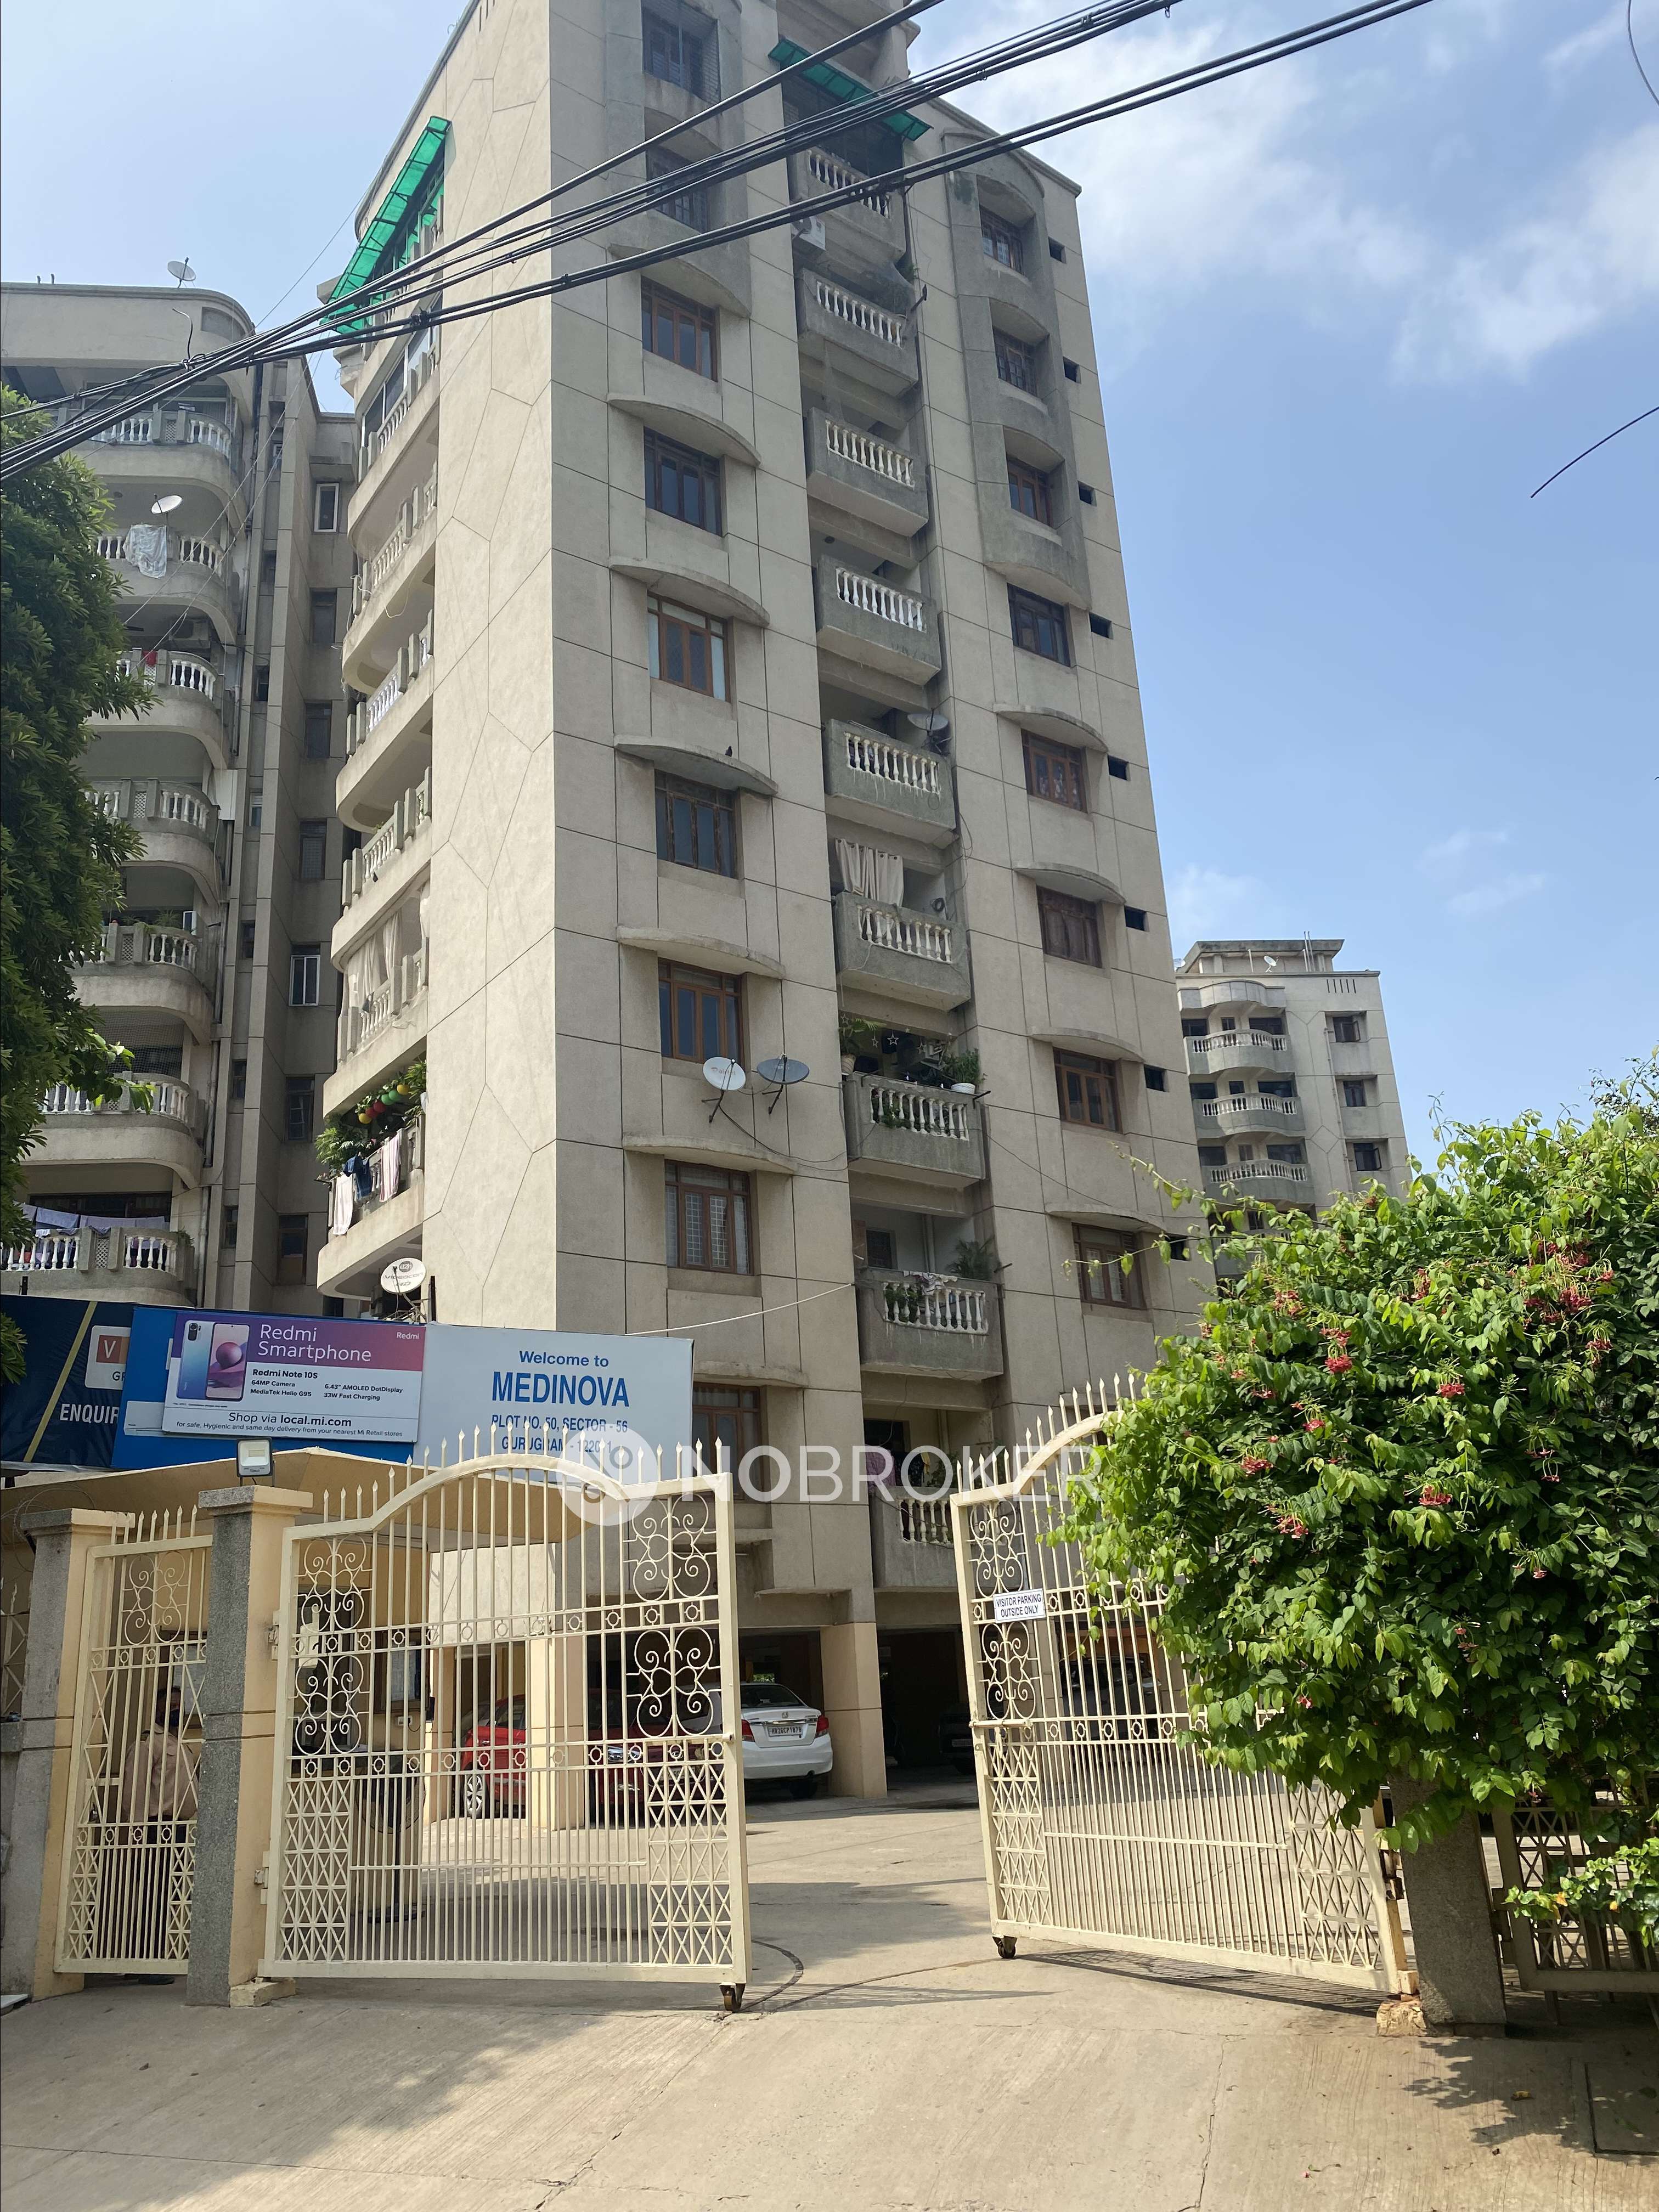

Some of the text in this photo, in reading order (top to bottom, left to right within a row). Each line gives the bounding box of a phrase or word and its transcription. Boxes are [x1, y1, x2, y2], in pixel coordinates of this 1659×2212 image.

[260, 1324, 317, 1341] Redmi
[104, 1340, 116, 1358] V
[258, 1341, 371, 1362] Smartphone
[519, 1350, 609, 1367] Welcome to
[492, 1371, 629, 1407] MEDINOVA
[228, 1412, 352, 1426] Shop via local.mi.com
[492, 1414, 521, 1428] PLOT
[523, 1415, 541, 1429] NO.
[562, 1417, 606, 1432] SECTOR
[616, 1420, 628, 1433] 56
[996, 1593, 1041, 1607] VISITOR PARKING
[1001, 1605, 1039, 1617] OUTSIDE ONLY
